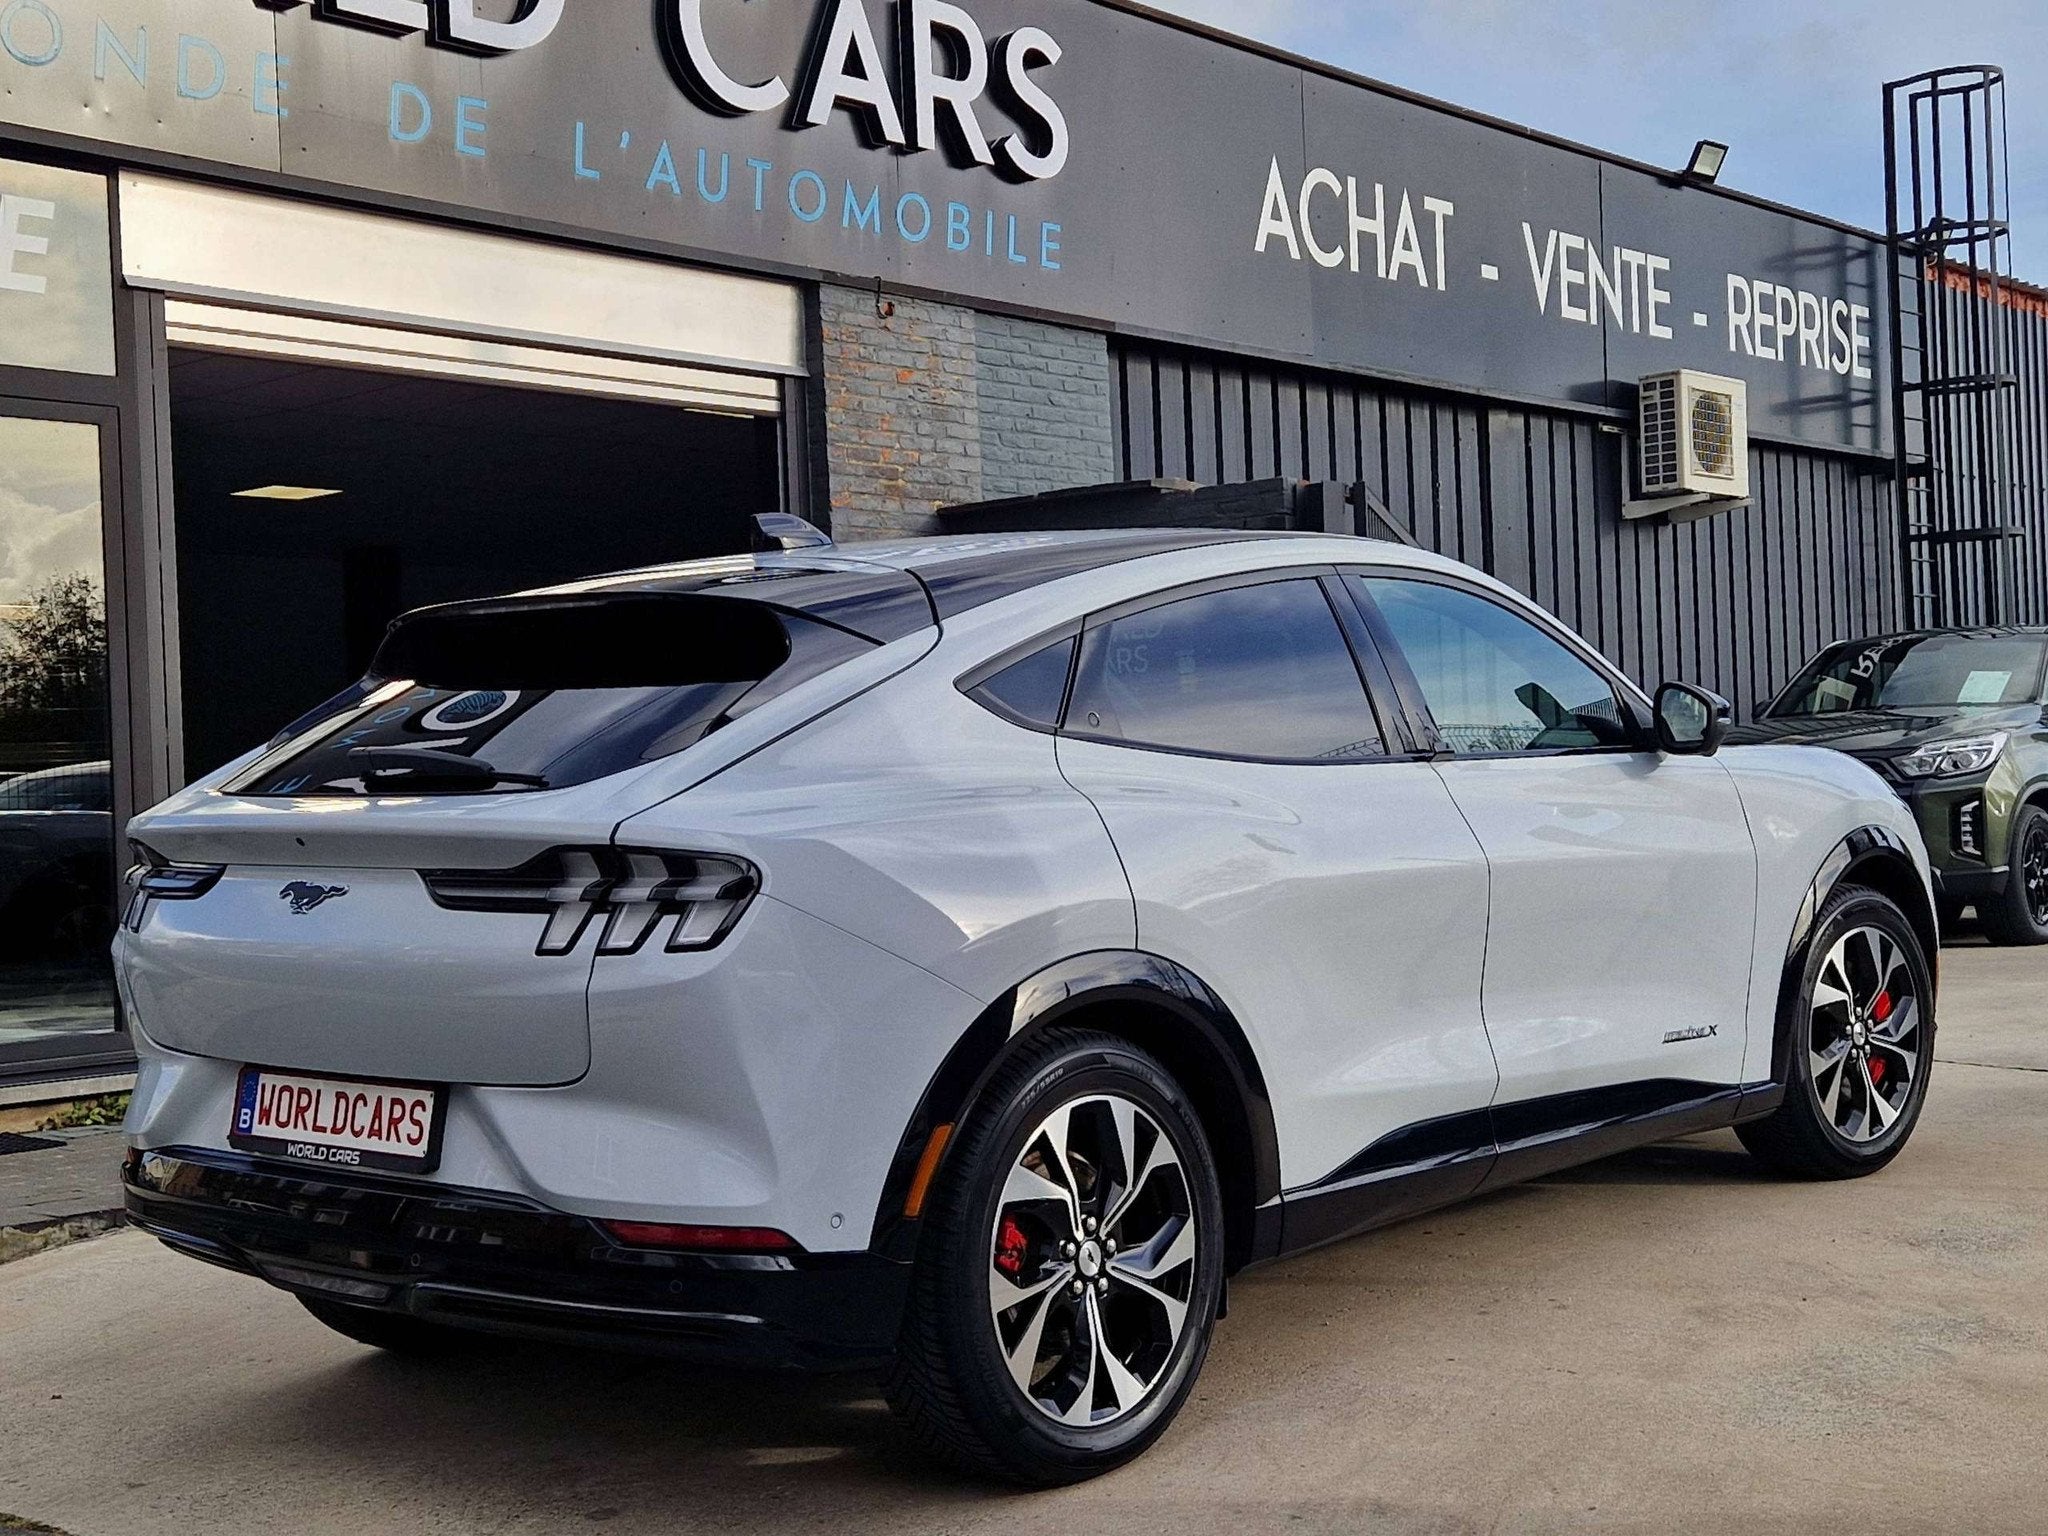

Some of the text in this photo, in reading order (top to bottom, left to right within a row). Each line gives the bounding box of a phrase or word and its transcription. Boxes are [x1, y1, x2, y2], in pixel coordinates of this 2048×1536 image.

[0, 0, 290, 118] ONDE
[388, 80, 489, 158] DE
[573, 121, 1063, 271] L'AUTOMOBILE
[672, 0, 1070, 180] CARS
[1253, 154, 1455, 292] ACHAT
[1521, 220, 1673, 341] VENTE
[1726, 272, 1873, 379] REPRISE
[238, 1108, 252, 1129] B
[256, 1082, 428, 1146] WORLDCARS
[286, 1142, 361, 1165] WORLD CARS
